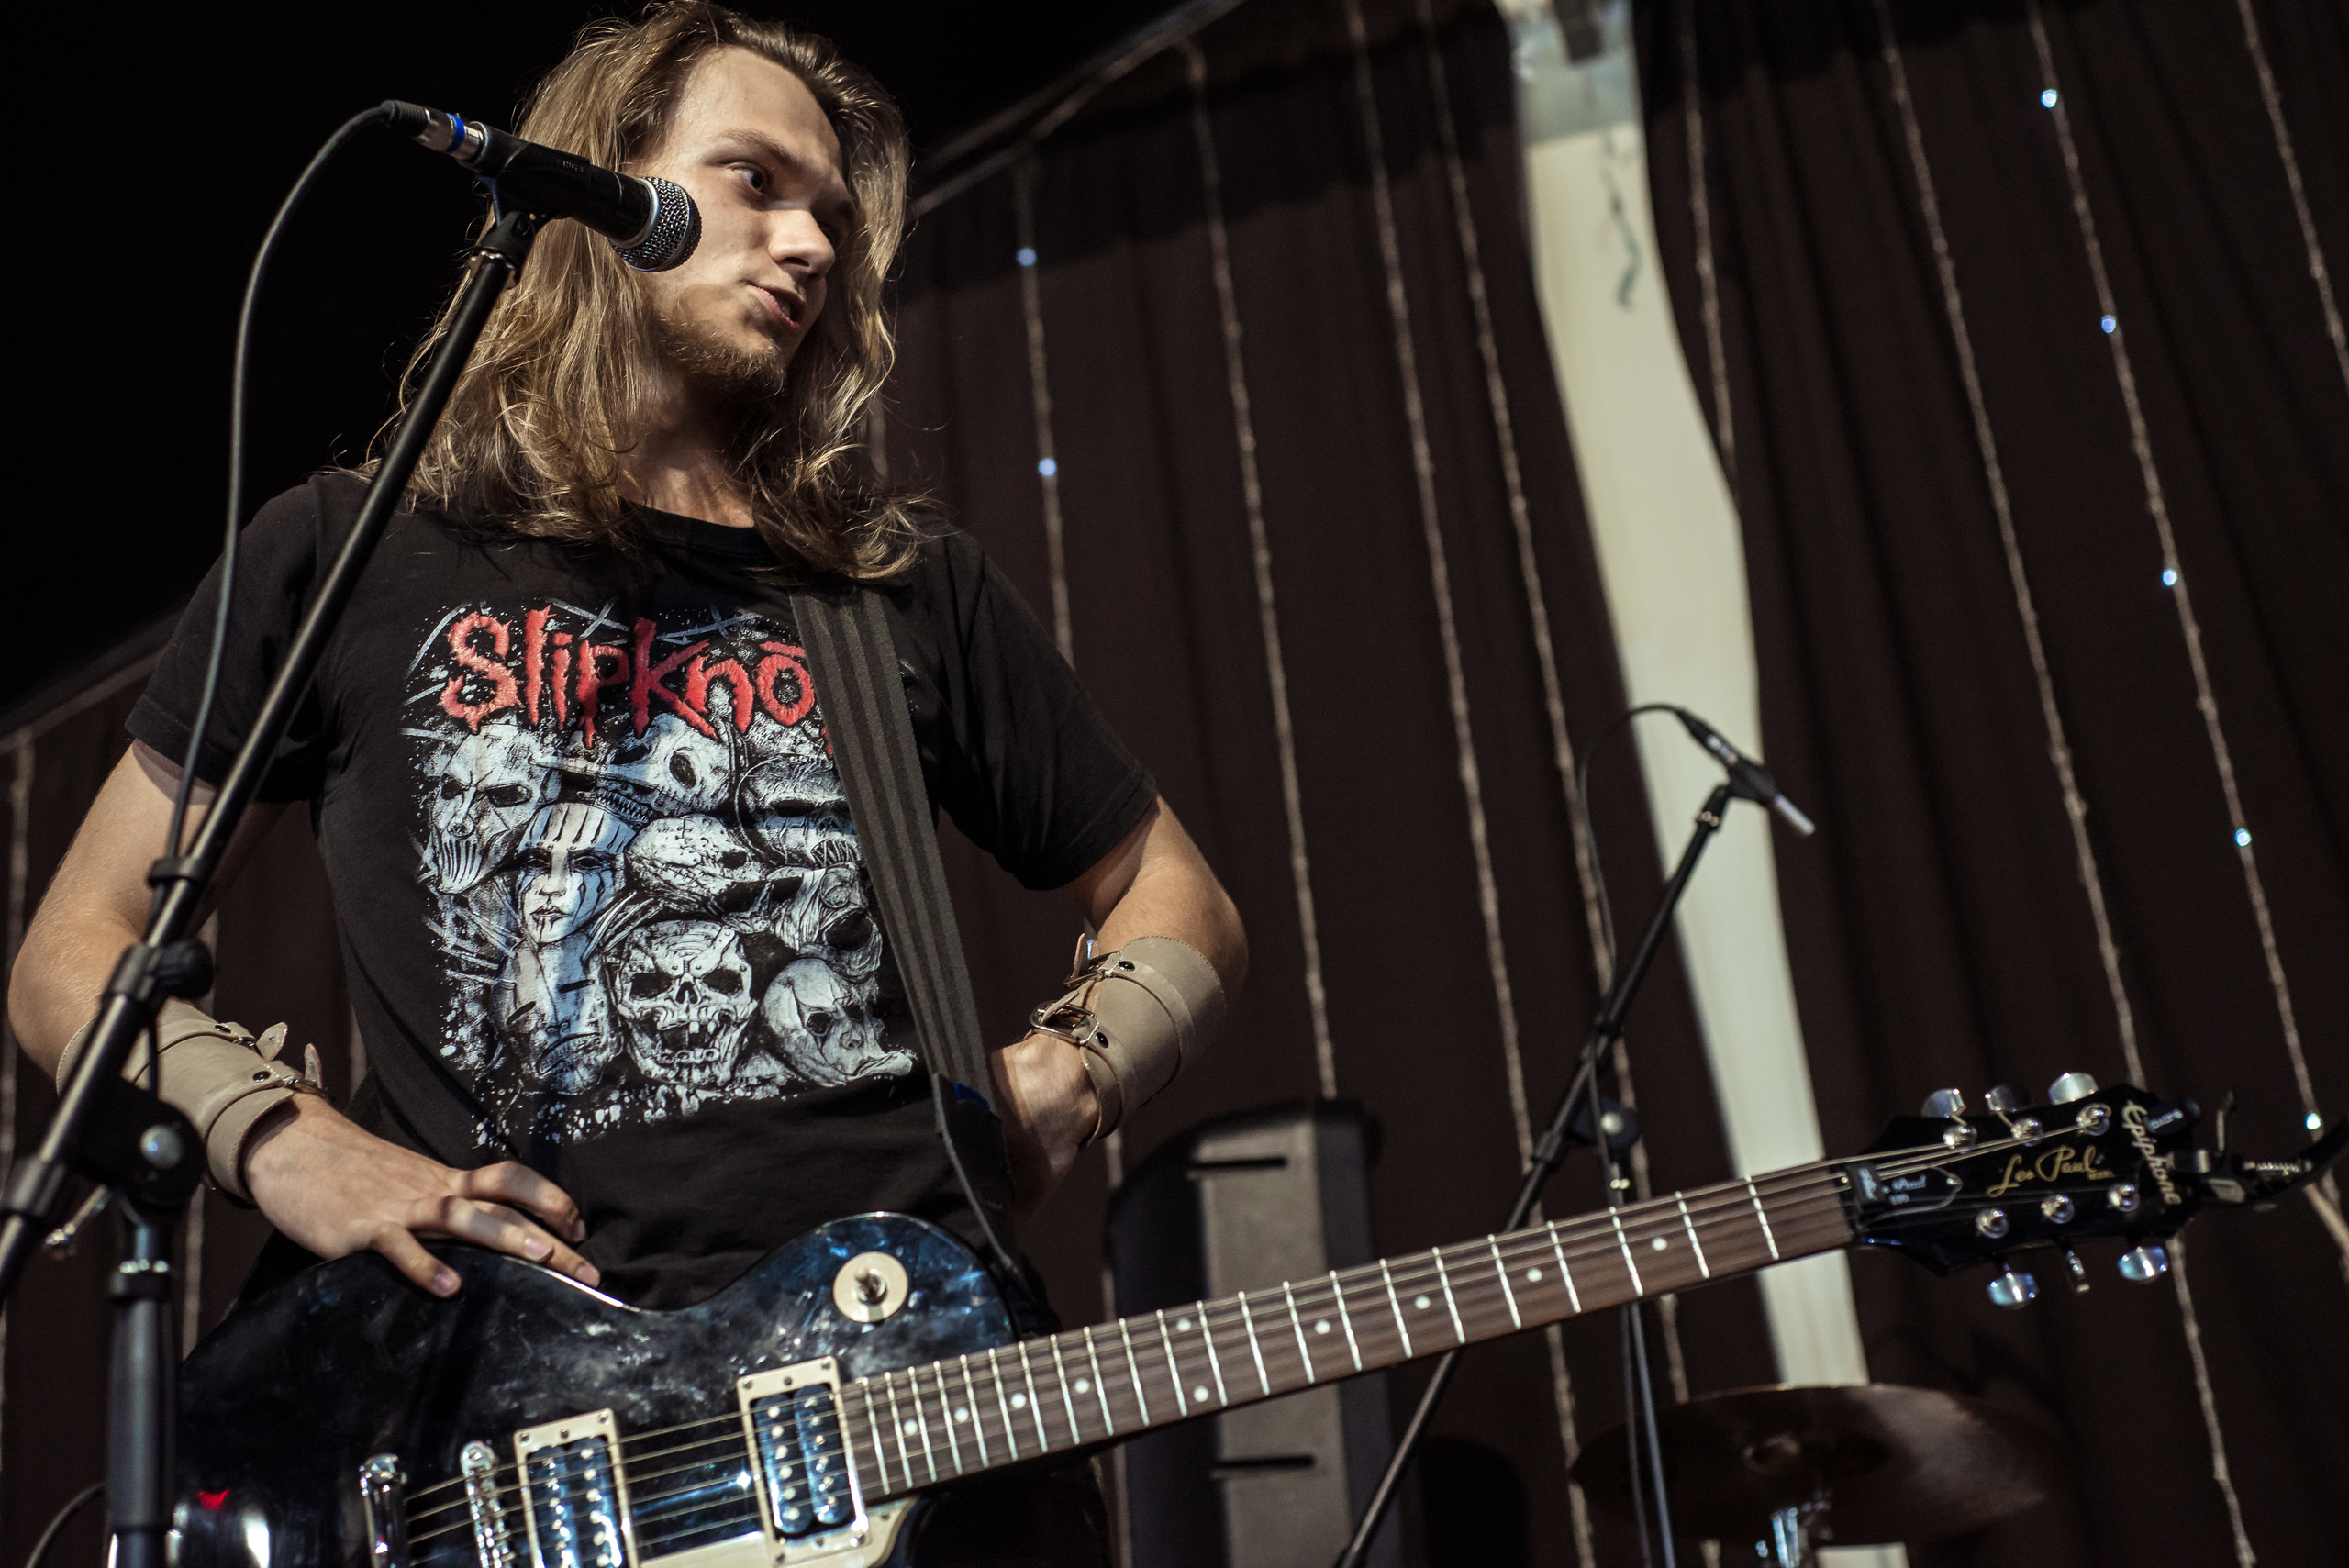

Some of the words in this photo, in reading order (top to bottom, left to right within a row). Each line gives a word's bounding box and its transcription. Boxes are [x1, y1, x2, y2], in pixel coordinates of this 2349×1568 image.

[441, 604, 831, 756] Slipkno
[1986, 1154, 2035, 1197] Les
[2035, 1144, 2098, 1182] Paul
[2121, 1100, 2182, 1205] Epiphone
